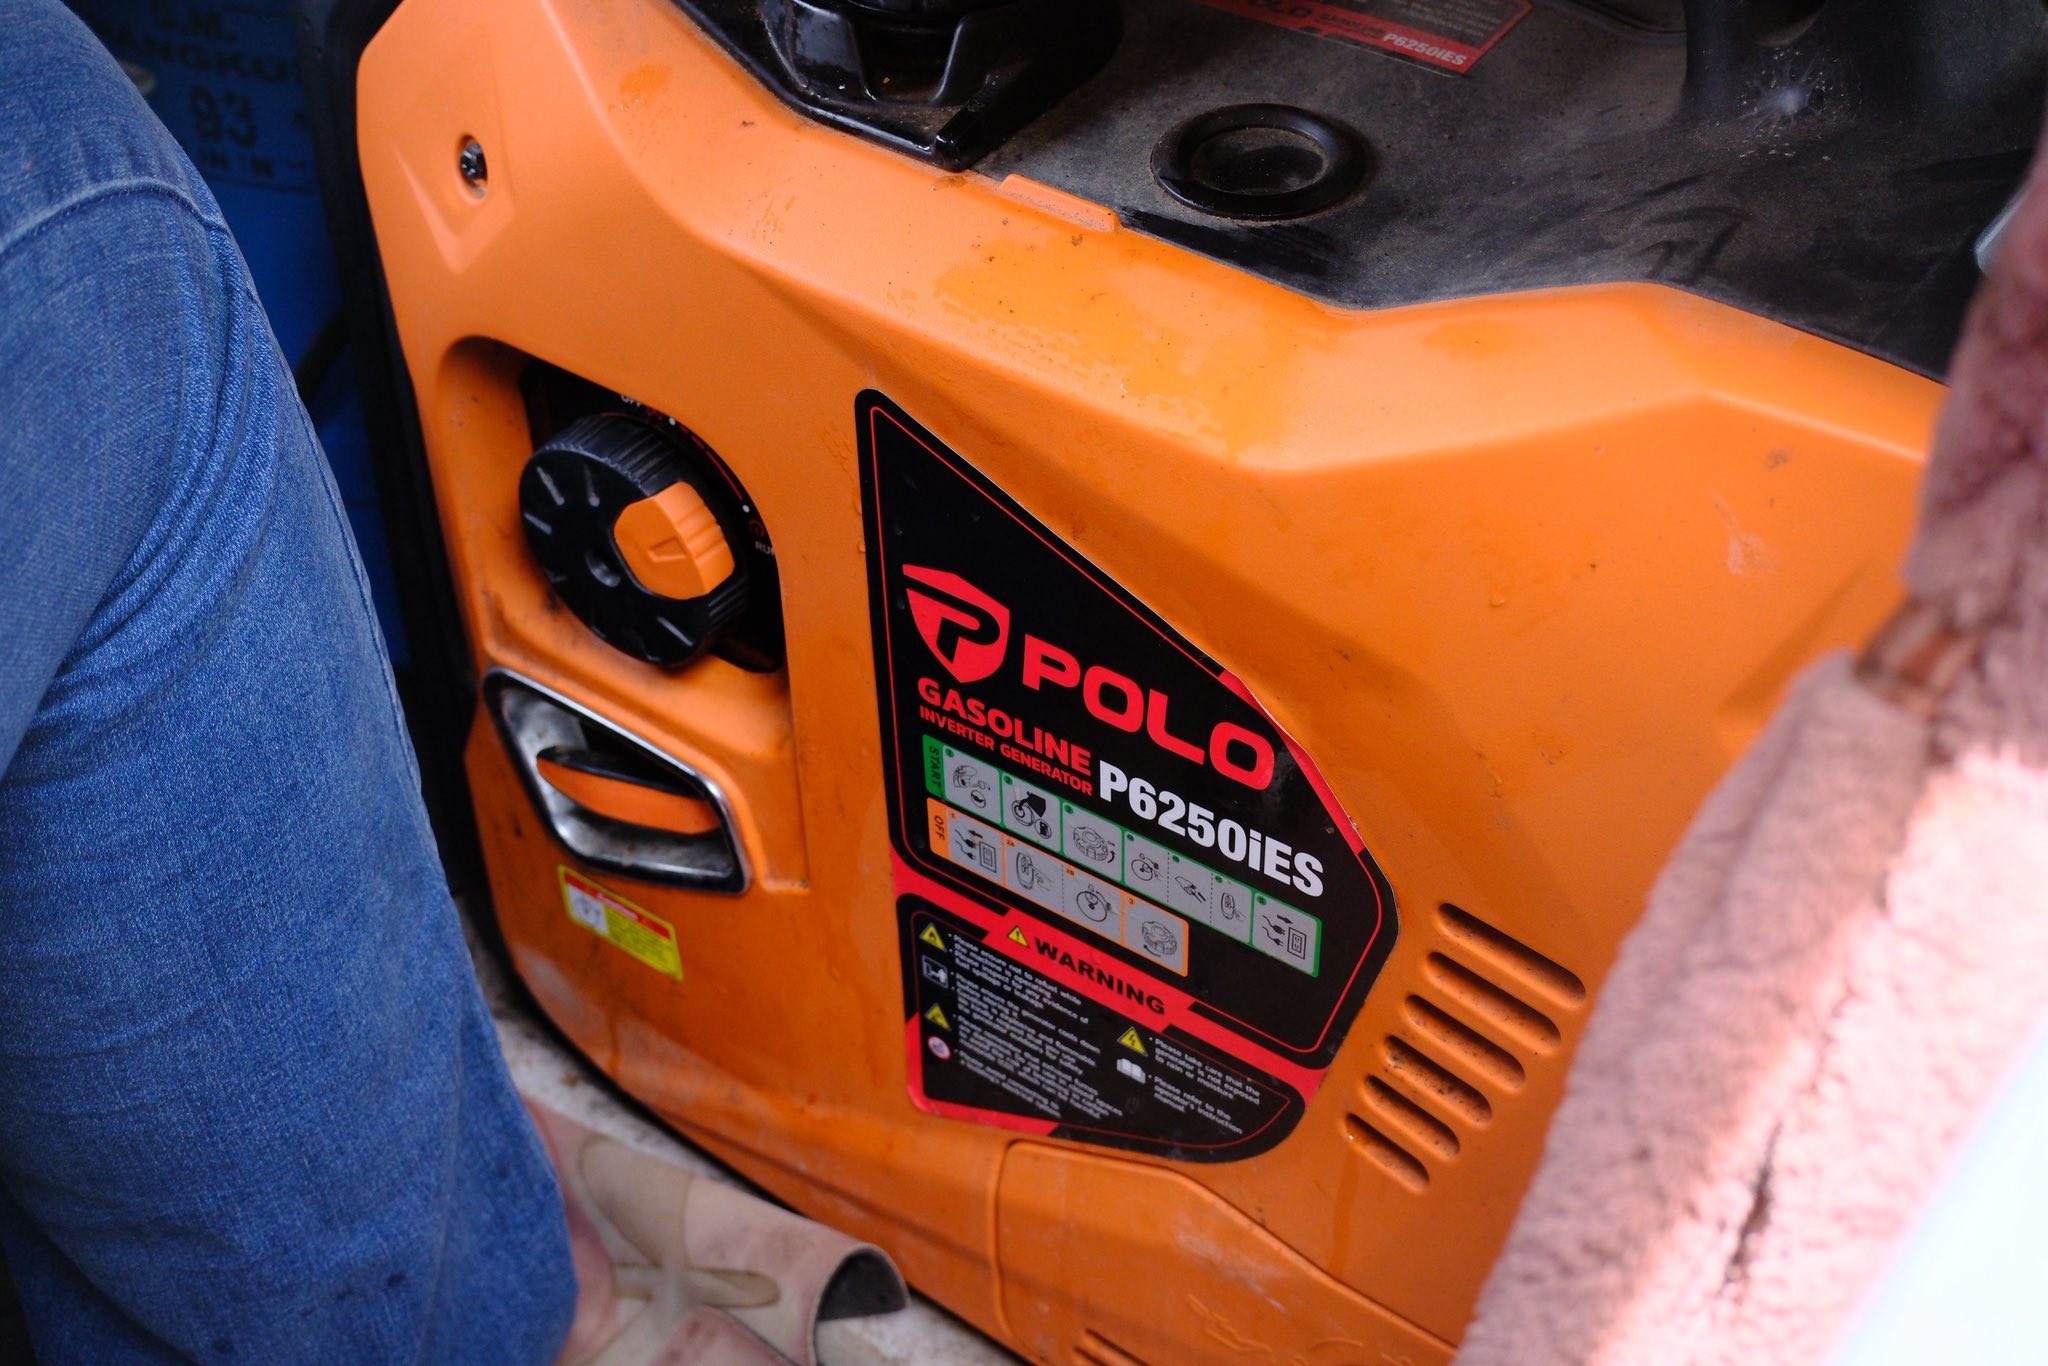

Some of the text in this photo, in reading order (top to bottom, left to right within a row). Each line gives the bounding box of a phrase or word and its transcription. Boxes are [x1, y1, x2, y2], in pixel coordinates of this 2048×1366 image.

[190, 84, 258, 147] 93
[917, 677, 1092, 777] GASOLINE
[1022, 633, 1276, 791] POLO
[919, 705, 1093, 797] INVERTER GENERATOR
[929, 746, 942, 792] START
[934, 814, 946, 841] OFF
[1099, 759, 1324, 898] P6250iES
[1034, 936, 1167, 1016] WARNING
[1155, 1054, 1164, 1064] to
[1166, 1060, 1183, 1074] rain
[1186, 1070, 1194, 1080] or
[1155, 1038, 1260, 1097] Please take care that the
[1155, 1046, 1260, 1106] generator is not exposed
[1154, 1076, 1181, 1096] Please
[1205, 1102, 1214, 1113] to
[1217, 1108, 1231, 1122] the
